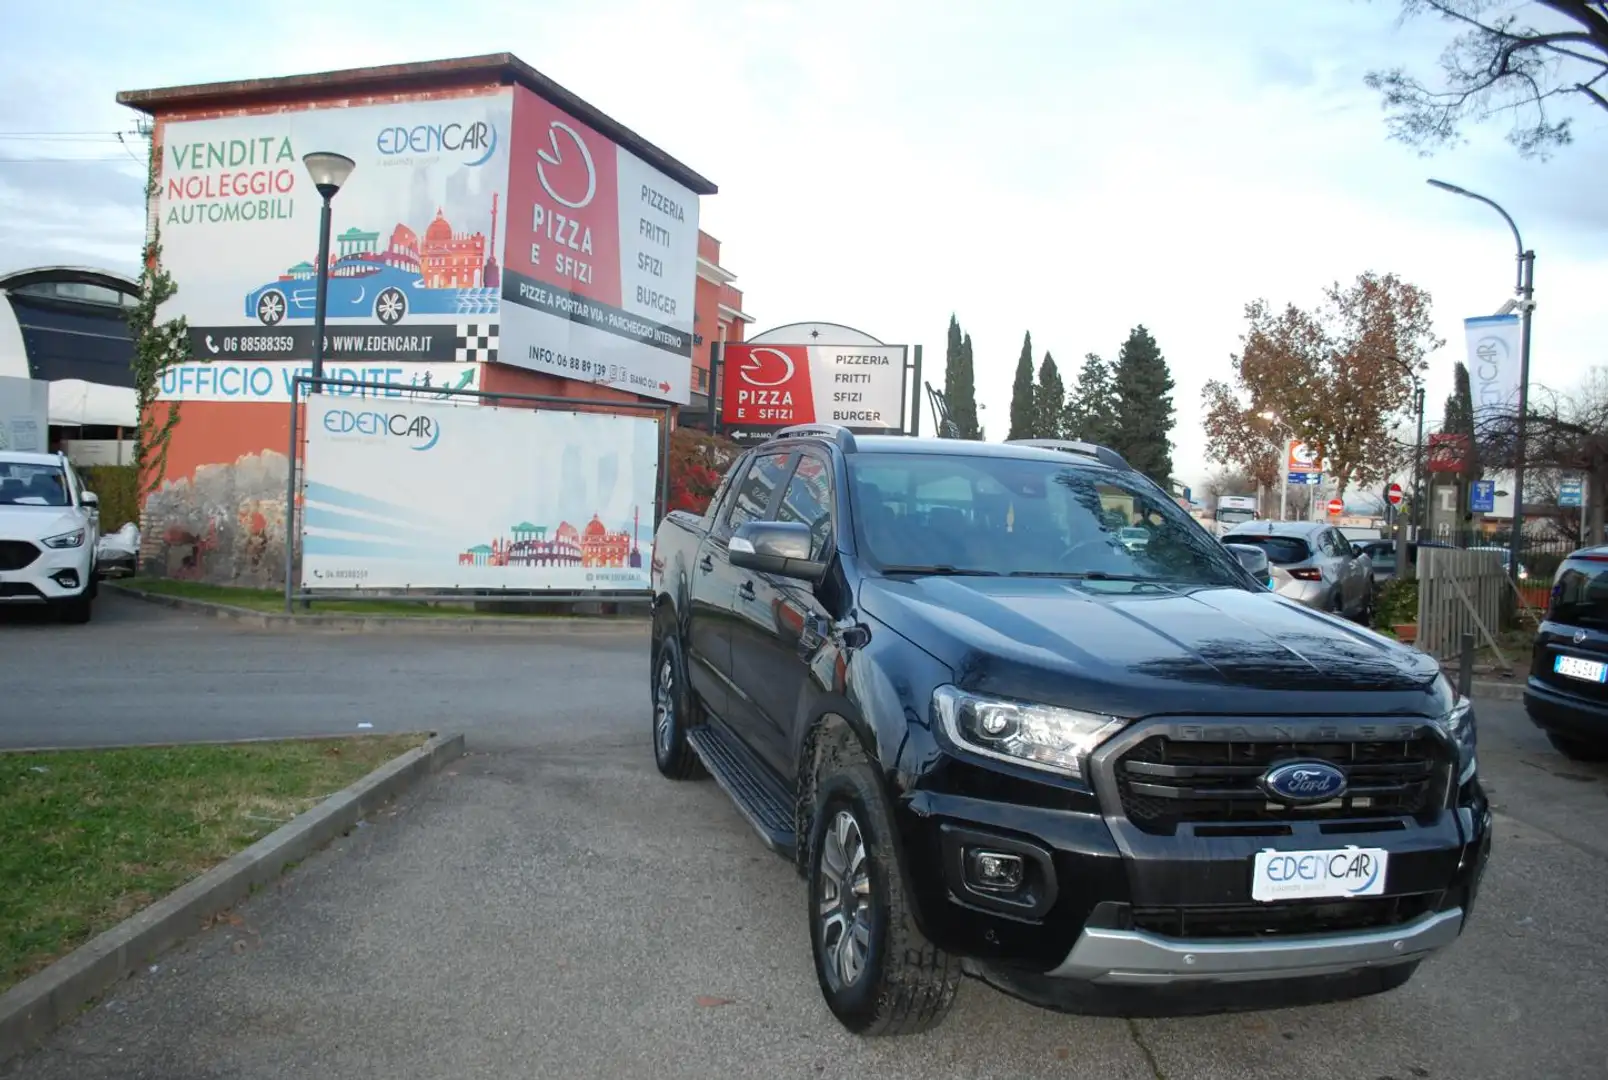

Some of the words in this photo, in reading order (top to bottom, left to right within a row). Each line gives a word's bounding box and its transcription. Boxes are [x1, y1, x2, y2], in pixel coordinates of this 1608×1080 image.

[377, 122, 488, 154] EDENCAR
[172, 137, 295, 169] VENDITA
[167, 169, 295, 200] NOLEGGIO
[166, 199, 294, 225] AUTOMOBILI
[642, 185, 684, 223] PIZZERIA
[533, 204, 593, 255] PIZZA
[639, 218, 670, 249] FRITTI
[531, 244, 540, 265] E
[555, 253, 593, 285] SFIZI
[637, 252, 663, 278] SFIZI
[636, 285, 677, 316] BURGER
[520, 283, 546, 304] PIZZE
[547, 293, 554, 309] A
[555, 295, 589, 318] PORTAR
[590, 308, 604, 323] VIA
[609, 314, 654, 338] PARCHEGGIO
[655, 330, 682, 348] INTERNO
[224, 336, 239, 352] 06
[240, 335, 294, 352] 88588359
[333, 335, 432, 352] WWW.EDENCAR.IT
[528, 344, 556, 364] INFO:
[556, 352, 568, 369] 06
[569, 355, 581, 372] 88
[581, 358, 592, 374] 89
[592, 362, 607, 378] 139
[836, 355, 889, 365] PIZZERIA
[161, 366, 273, 396] UFFICIO
[835, 374, 871, 383] FRITTI
[739, 391, 793, 404] PIZZA
[833, 393, 862, 402] SFIZI
[323, 409, 432, 438] EDENCAR
[738, 409, 745, 418] E
[759, 409, 793, 419] SFIZI
[833, 411, 881, 421] BURGER
[749, 432, 772, 440] SIAMO
[1288, 769, 1330, 792] Ford
[1266, 853, 1371, 882] EDENCAR
